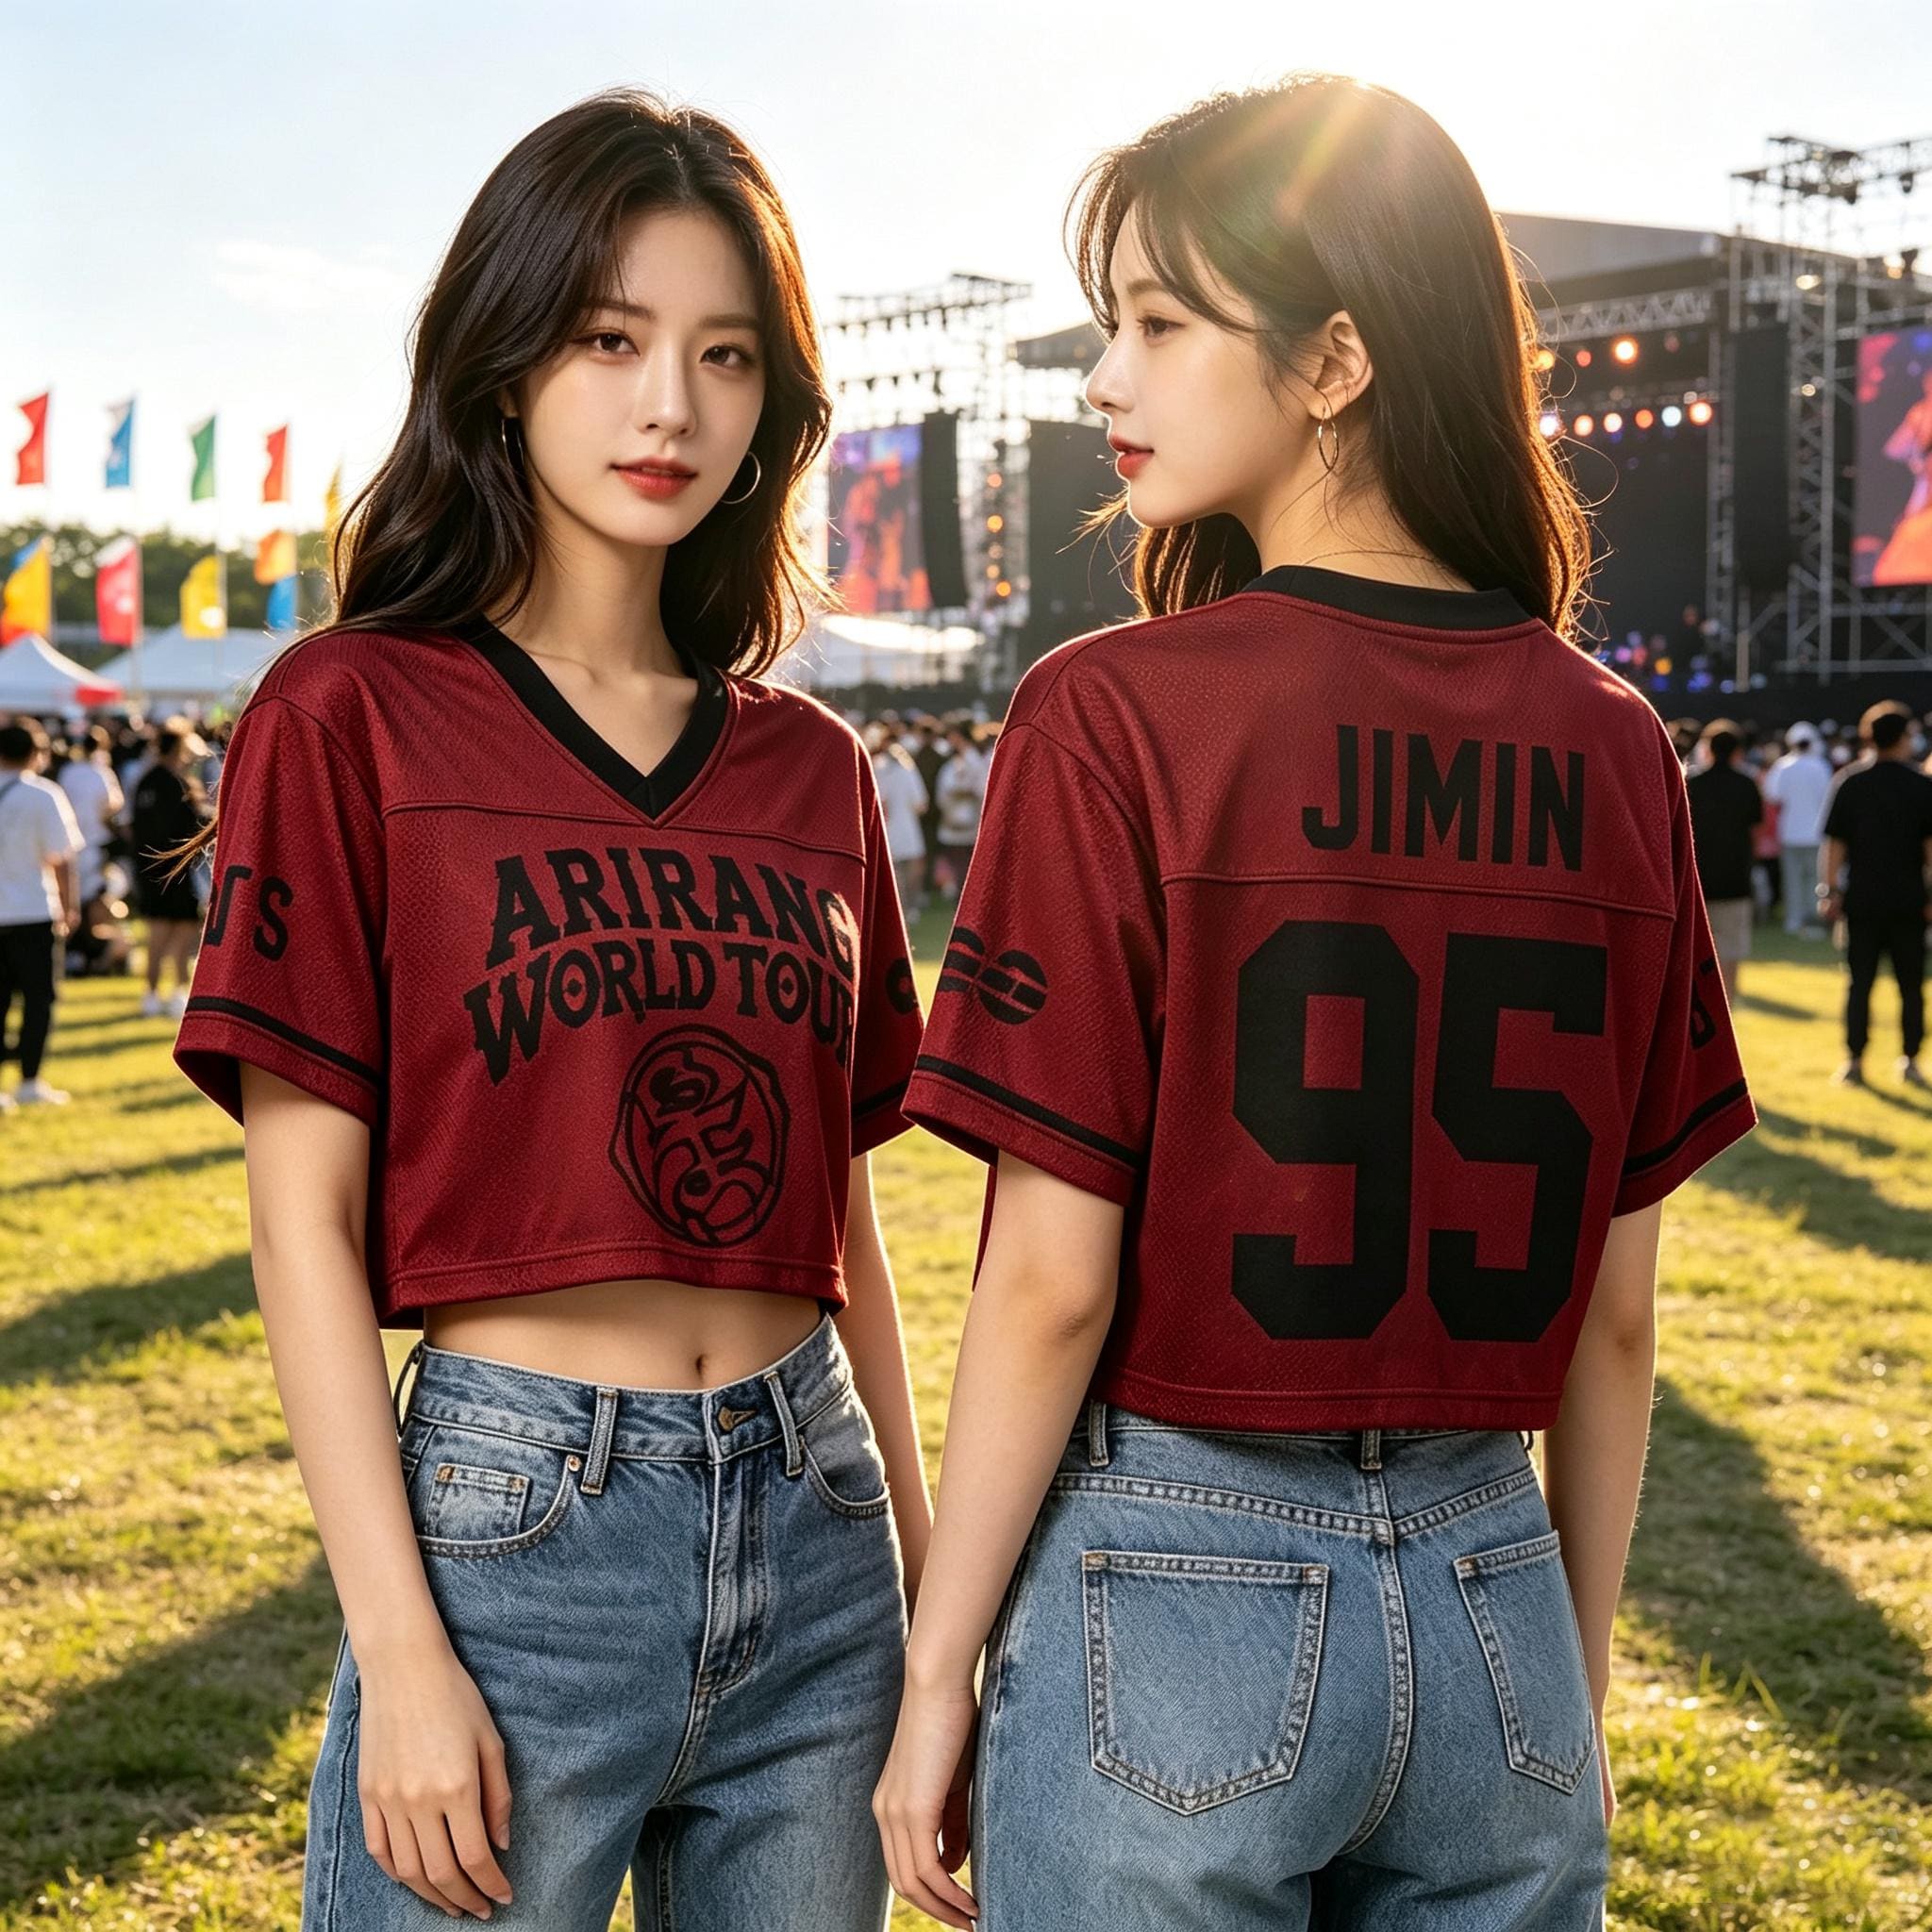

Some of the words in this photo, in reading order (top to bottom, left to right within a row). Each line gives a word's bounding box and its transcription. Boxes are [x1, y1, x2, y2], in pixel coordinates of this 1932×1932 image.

[1302, 724, 1586, 873] JIMIN
[463, 938, 716, 1087] WORLD
[1230, 919, 1608, 1342] 95
